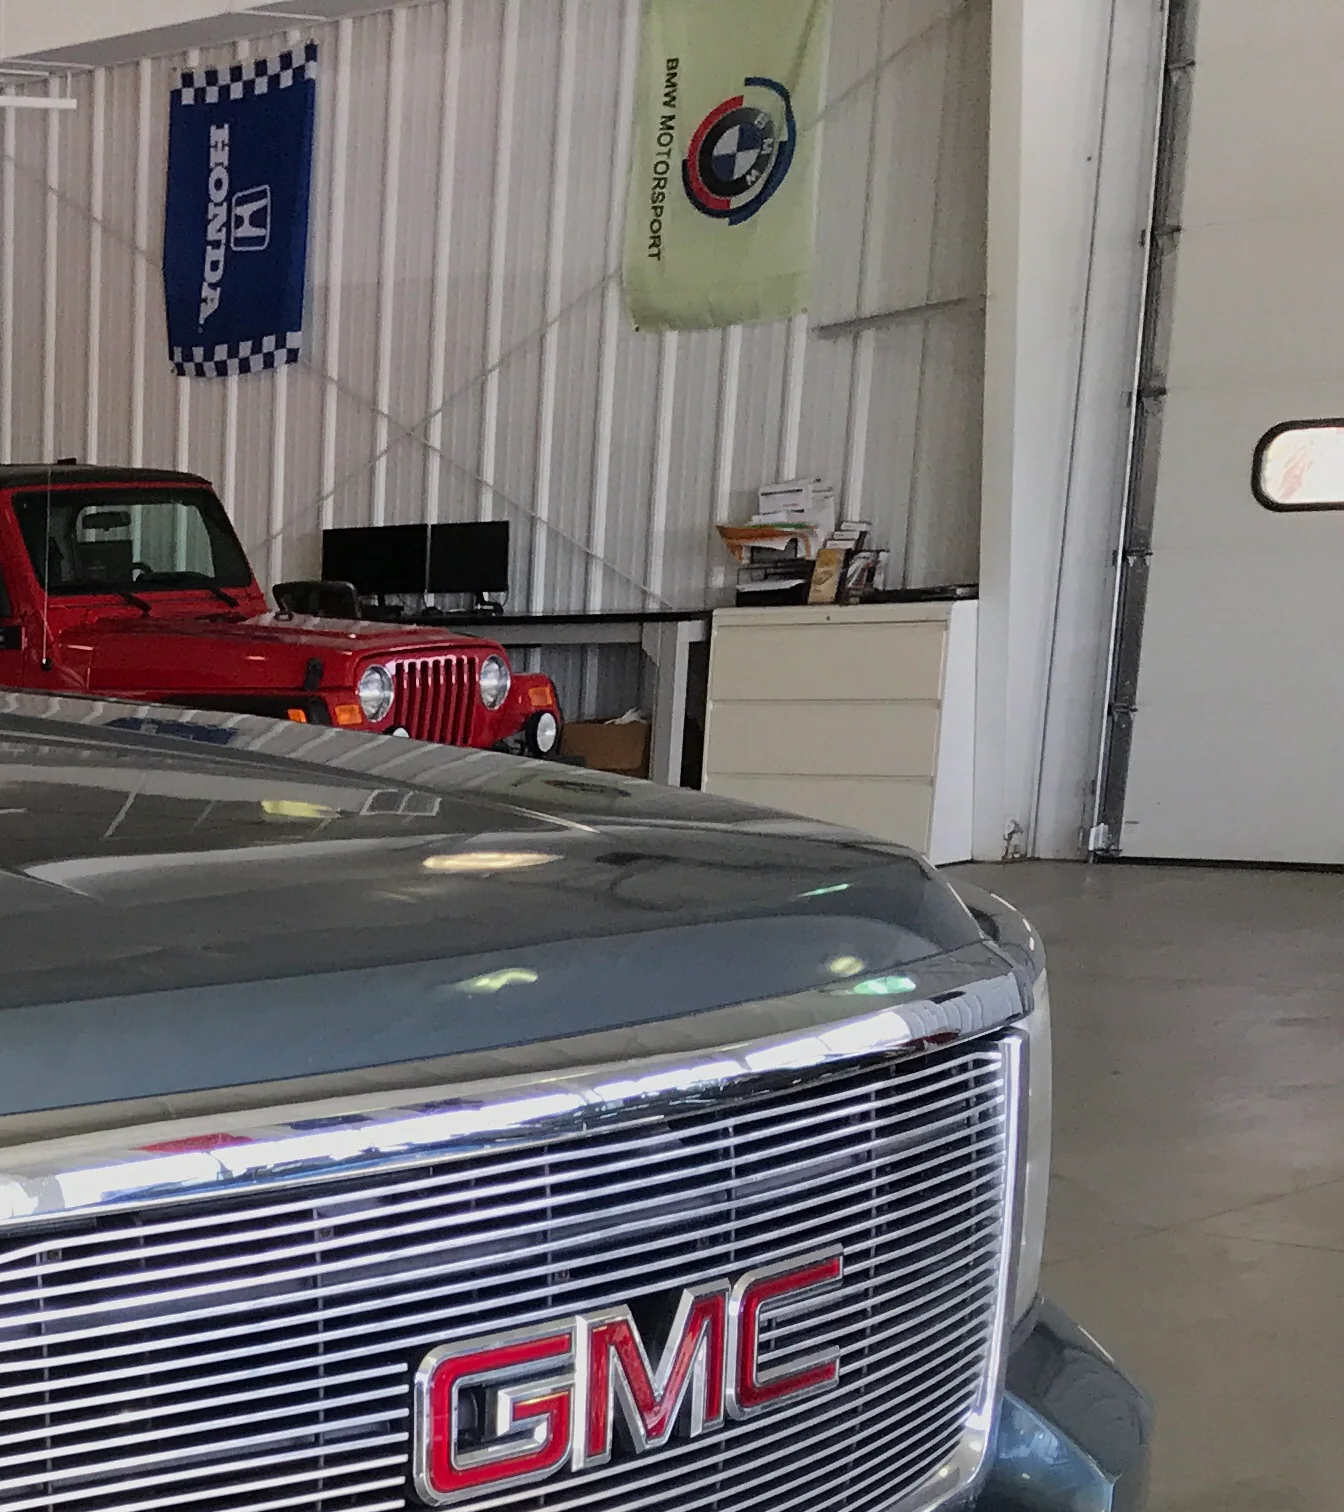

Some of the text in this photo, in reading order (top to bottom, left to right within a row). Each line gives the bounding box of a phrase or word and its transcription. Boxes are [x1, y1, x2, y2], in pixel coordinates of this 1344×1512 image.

[199, 123, 229, 325] HONDA
[648, 57, 679, 262] BMW MOTORSPORT
[414, 1244, 844, 1507] GMC
